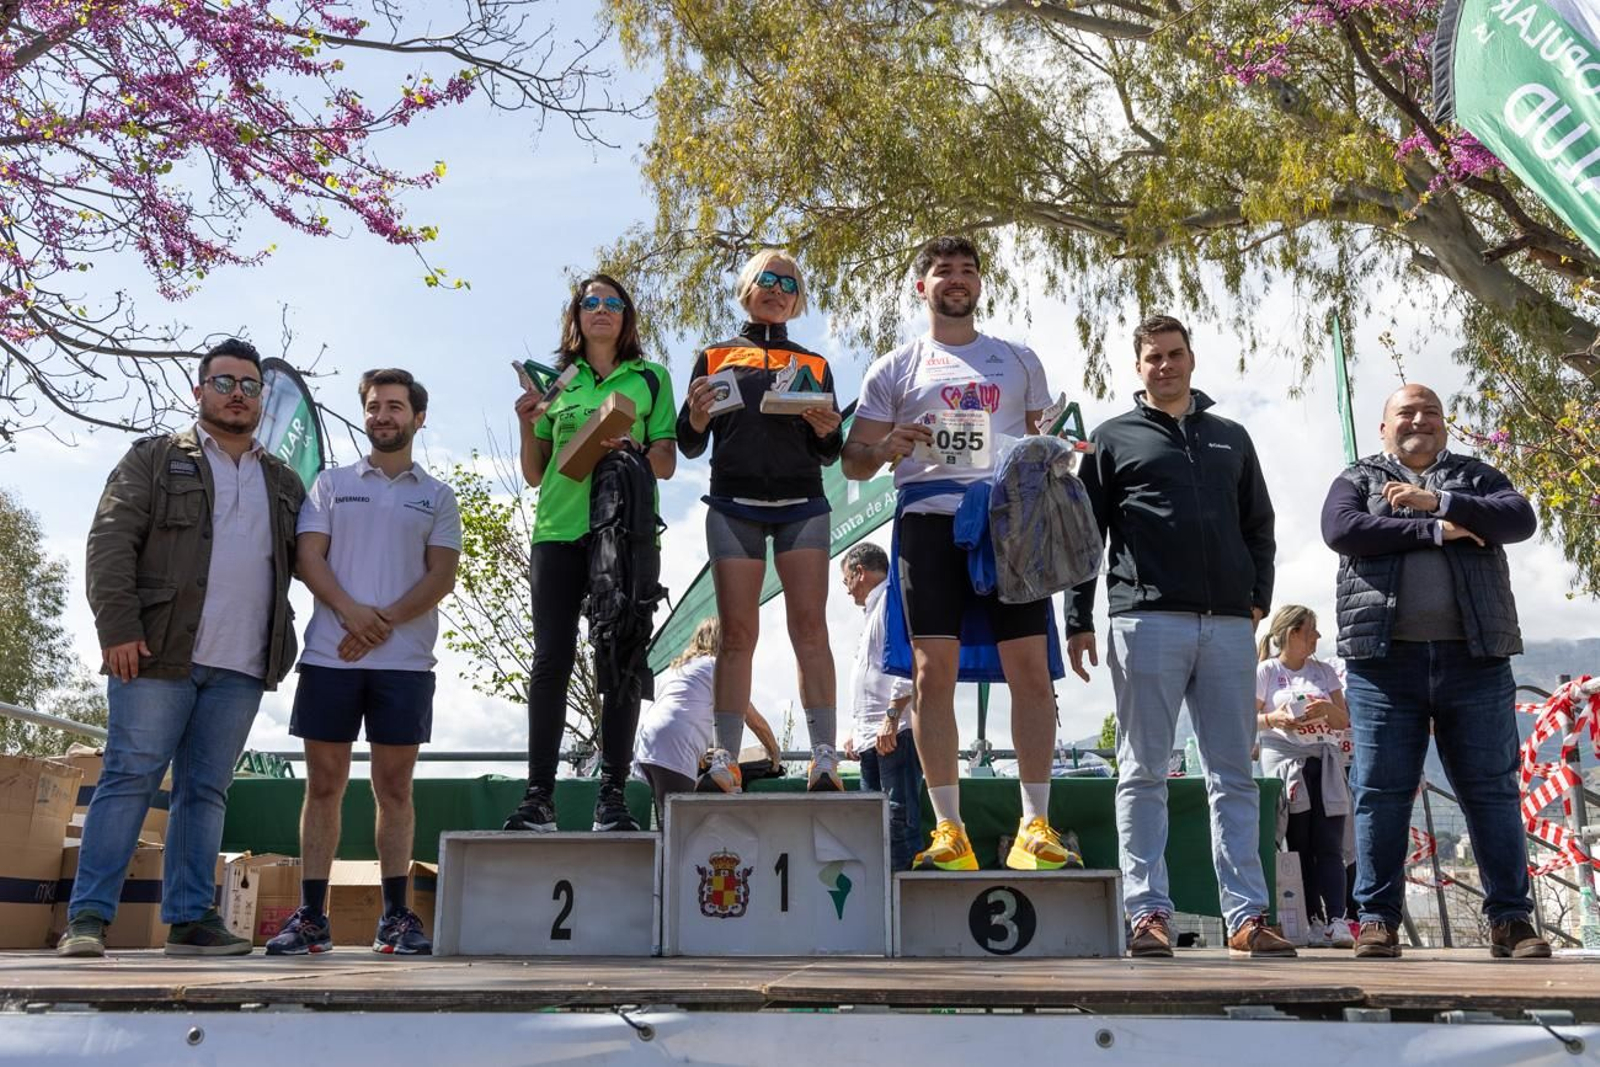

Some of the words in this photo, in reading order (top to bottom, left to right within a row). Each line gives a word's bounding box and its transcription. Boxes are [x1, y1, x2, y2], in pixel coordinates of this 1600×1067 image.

[866, 502, 882, 518] de
[551, 880, 573, 940] 2
[775, 853, 788, 912] 1
[987, 889, 1019, 951] 3
